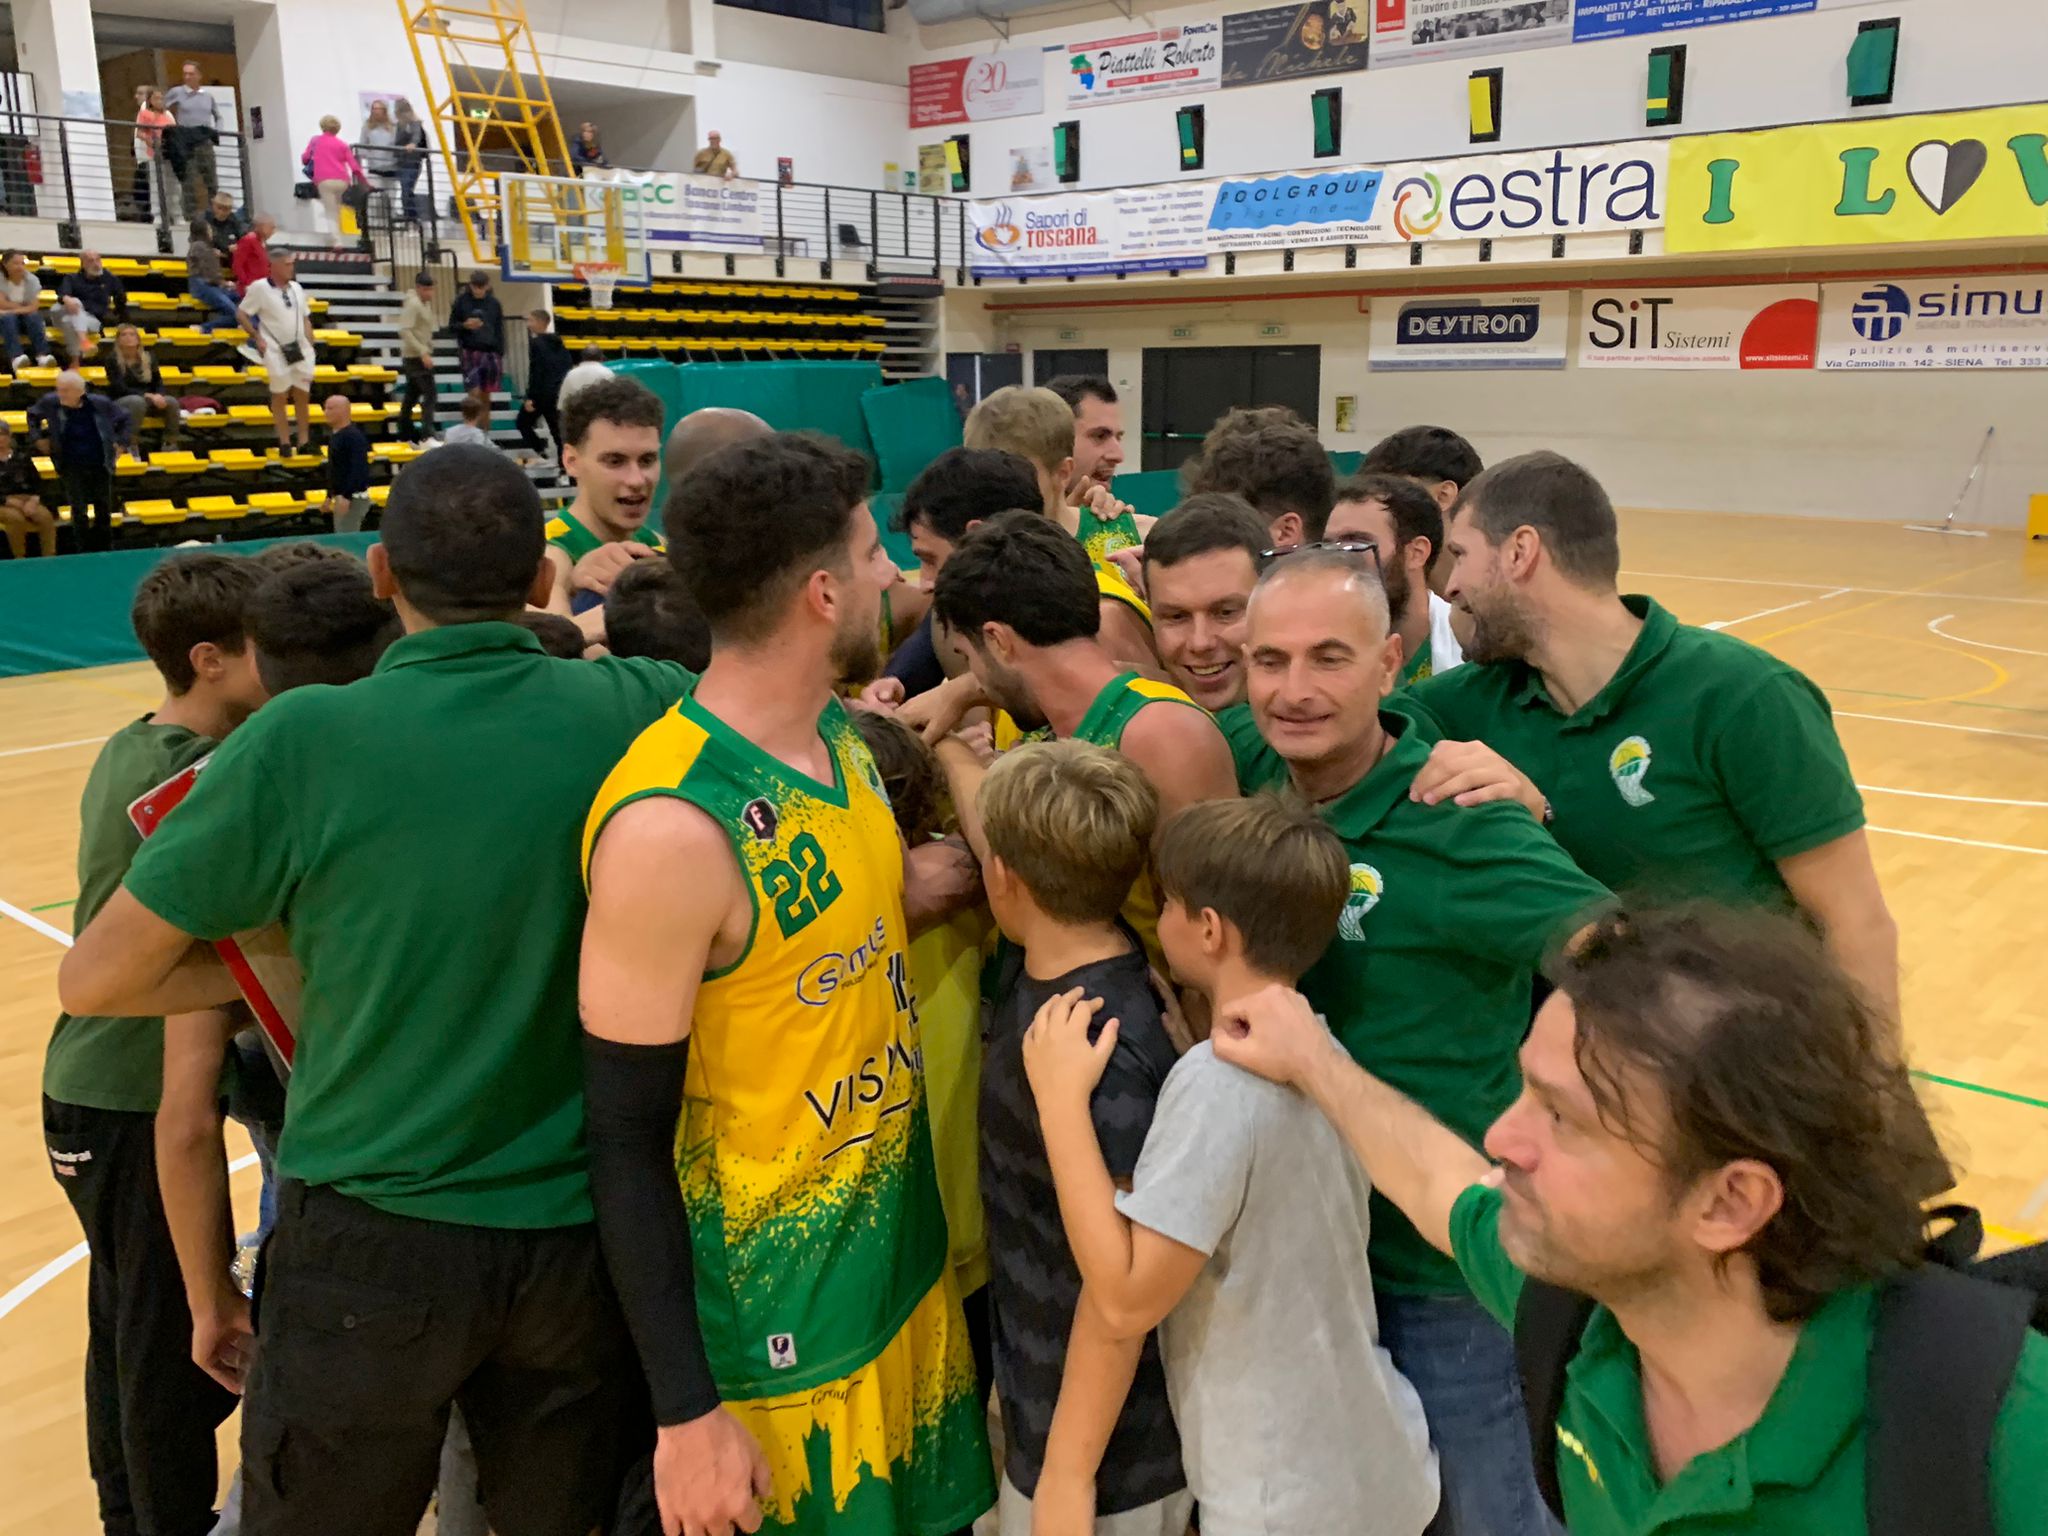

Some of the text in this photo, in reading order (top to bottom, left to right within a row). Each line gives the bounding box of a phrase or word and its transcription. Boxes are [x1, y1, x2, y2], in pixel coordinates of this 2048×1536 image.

[1421, 2, 1449, 14] lavoro
[1578, 3, 1617, 16] IMPIANTI
[1620, 1, 1631, 10] TV
[1606, 12, 1625, 22] RETI
[1627, 10, 1636, 19] IP
[1646, 6, 1665, 16] RETI
[1098, 48, 1156, 78] Piattelli
[1162, 37, 1216, 68] Roberto
[1220, 179, 1377, 205] POOLGROUP
[1450, 150, 1660, 231] estra
[1702, 158, 1741, 224] I
[1026, 207, 1087, 230] Sapori di
[1917, 284, 2048, 318] simu
[1409, 313, 1526, 337] DEYTRON
[1589, 298, 1731, 349] SiT Sistemi
[1825, 360, 1843, 368] Via
[1845, 359, 1896, 368] Camollia
[1913, 359, 1934, 367] 142
[1945, 358, 1984, 367] SIENA
[1850, 344, 2048, 357] pulizie & multiserv
[762, 831, 843, 941] 22
